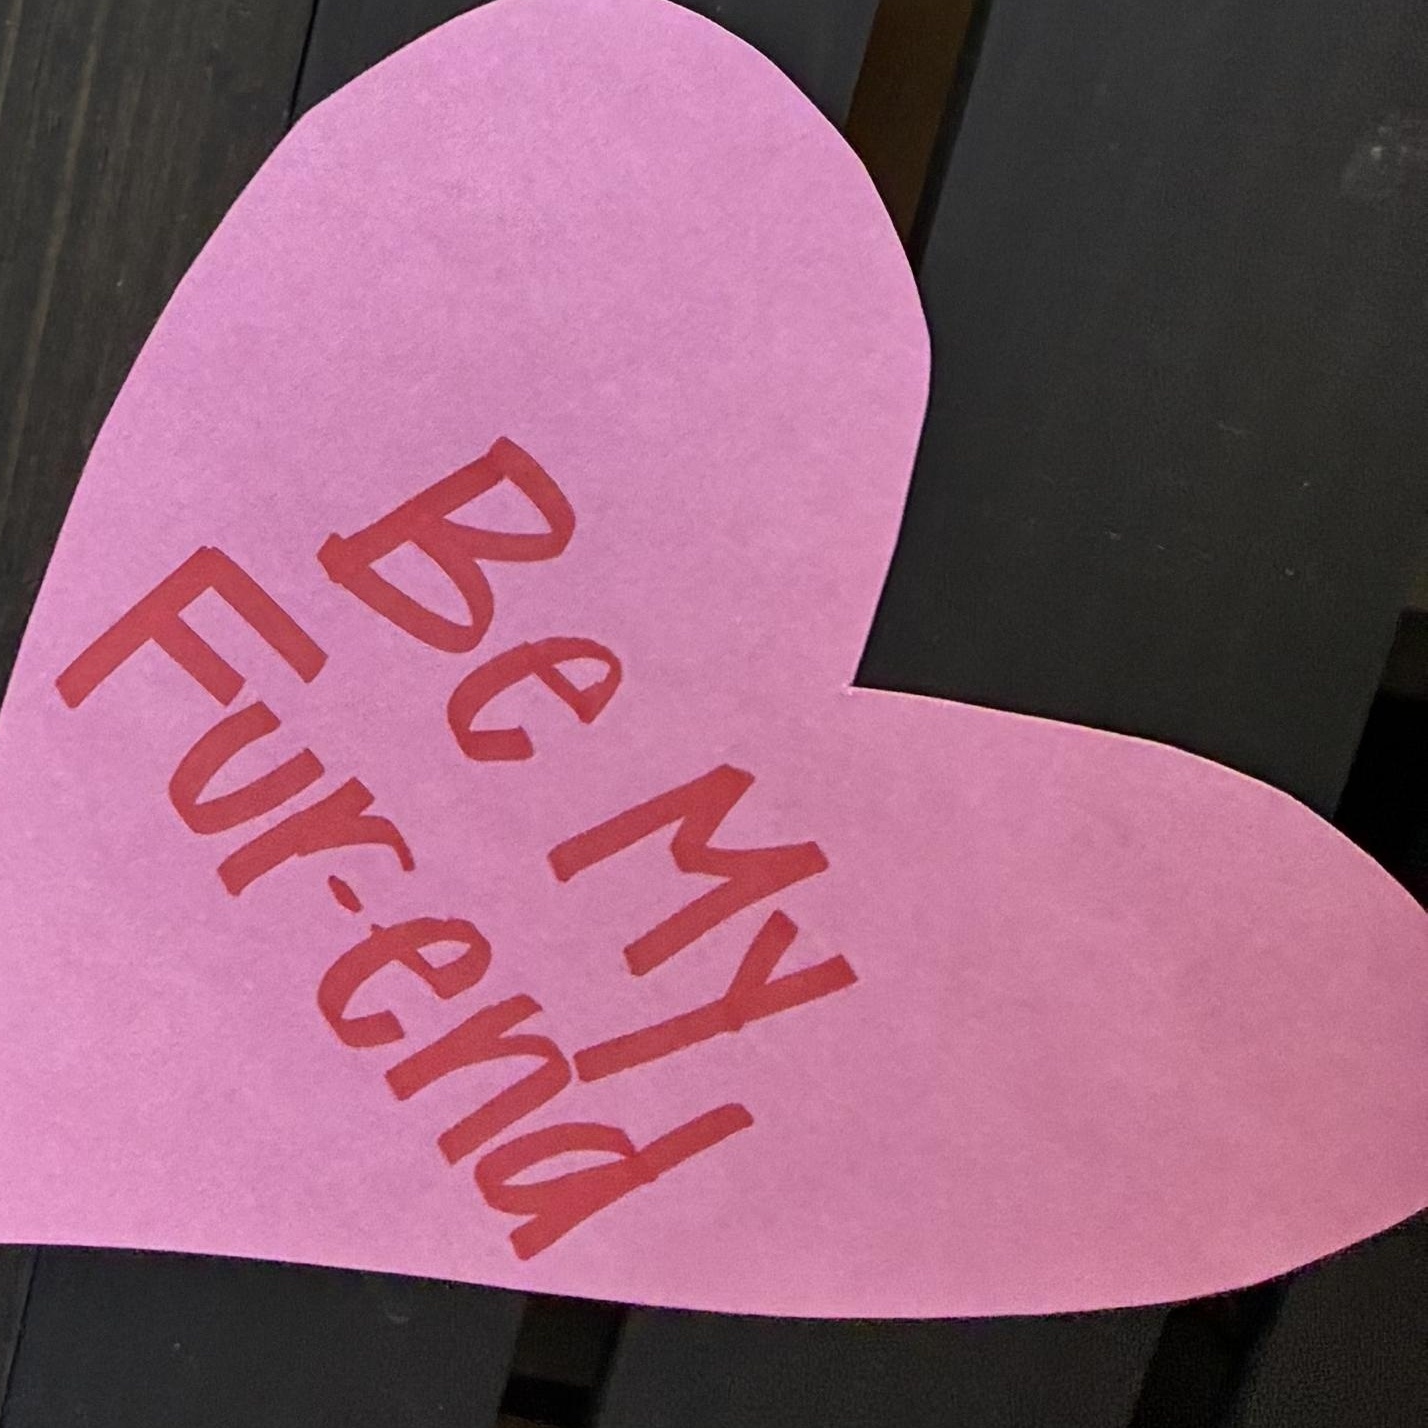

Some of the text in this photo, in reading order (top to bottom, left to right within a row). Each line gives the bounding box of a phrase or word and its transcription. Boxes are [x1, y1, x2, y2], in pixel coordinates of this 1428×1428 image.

[54, 545, 755, 1262] Fur-end
[315, 435, 860, 1085] Be My
